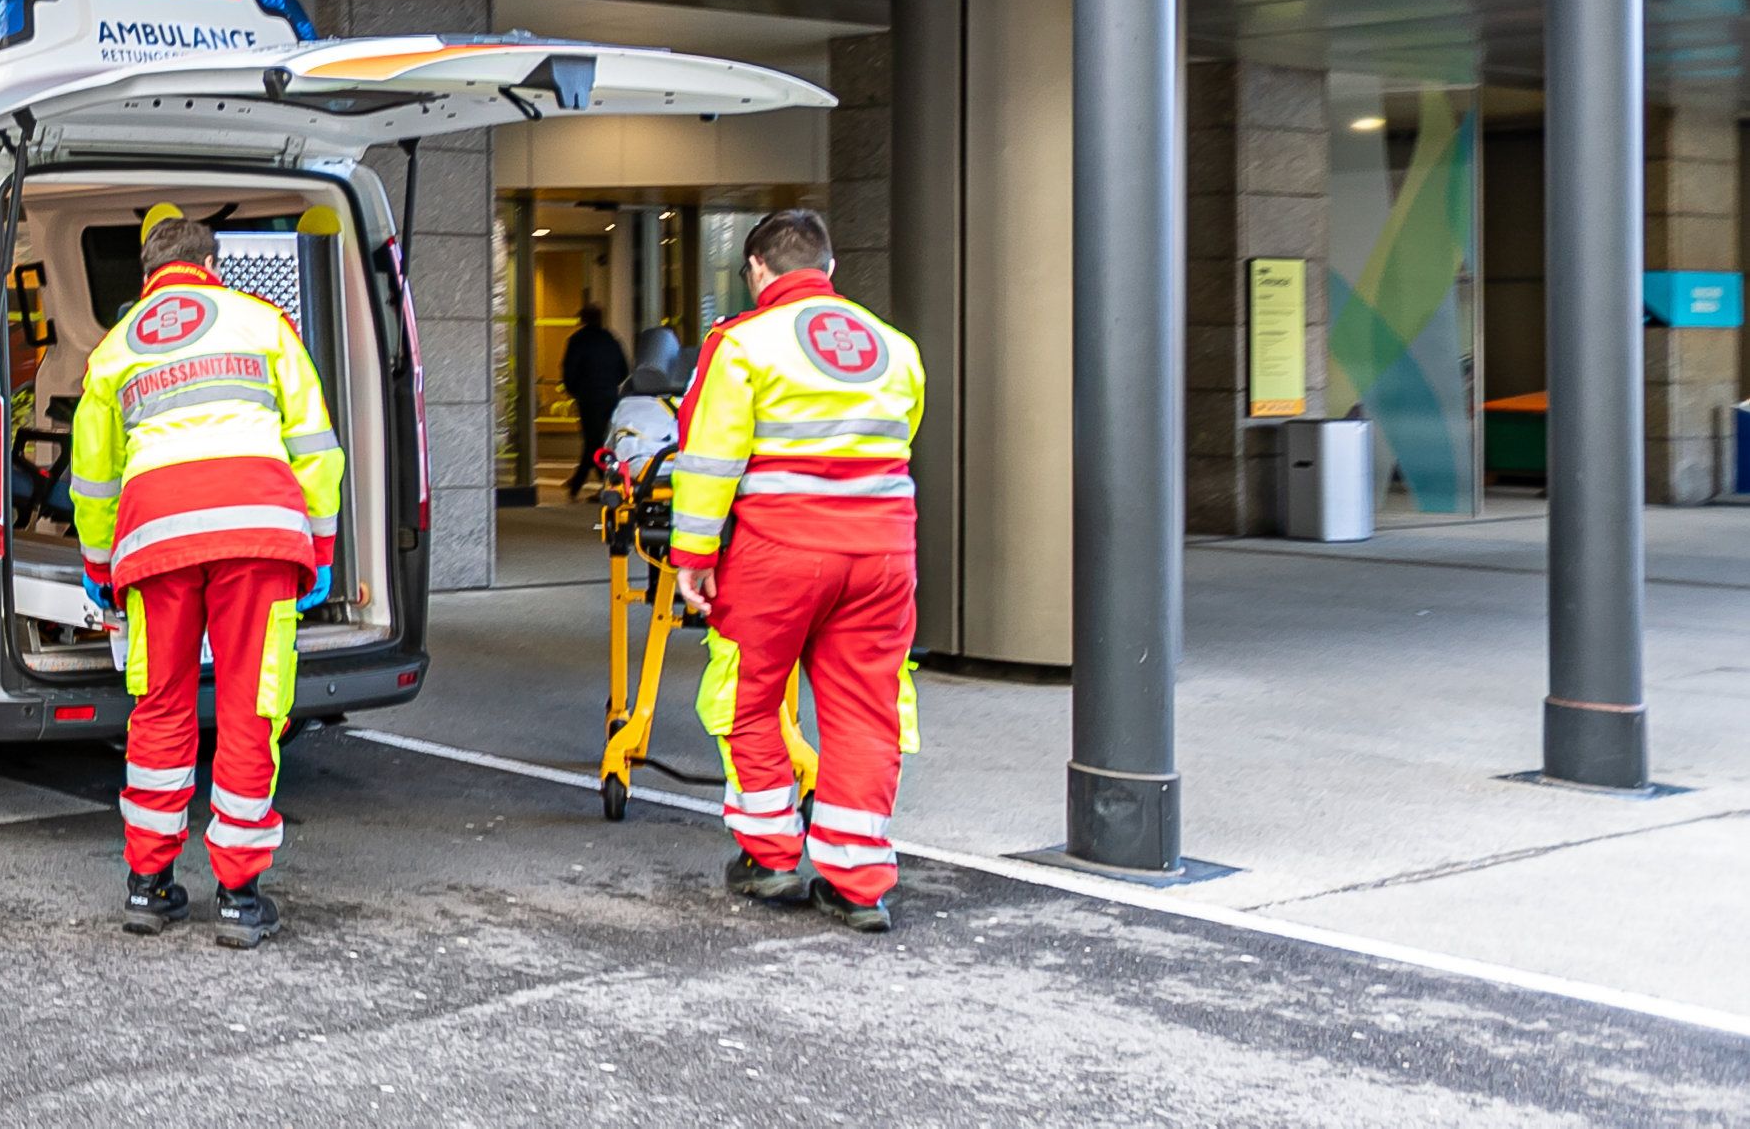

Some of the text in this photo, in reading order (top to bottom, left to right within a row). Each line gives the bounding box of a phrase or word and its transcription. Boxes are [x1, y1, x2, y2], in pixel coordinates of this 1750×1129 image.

[99, 21, 256, 50] AMBULANCE
[161, 309, 178, 328] S
[832, 330, 853, 351] S
